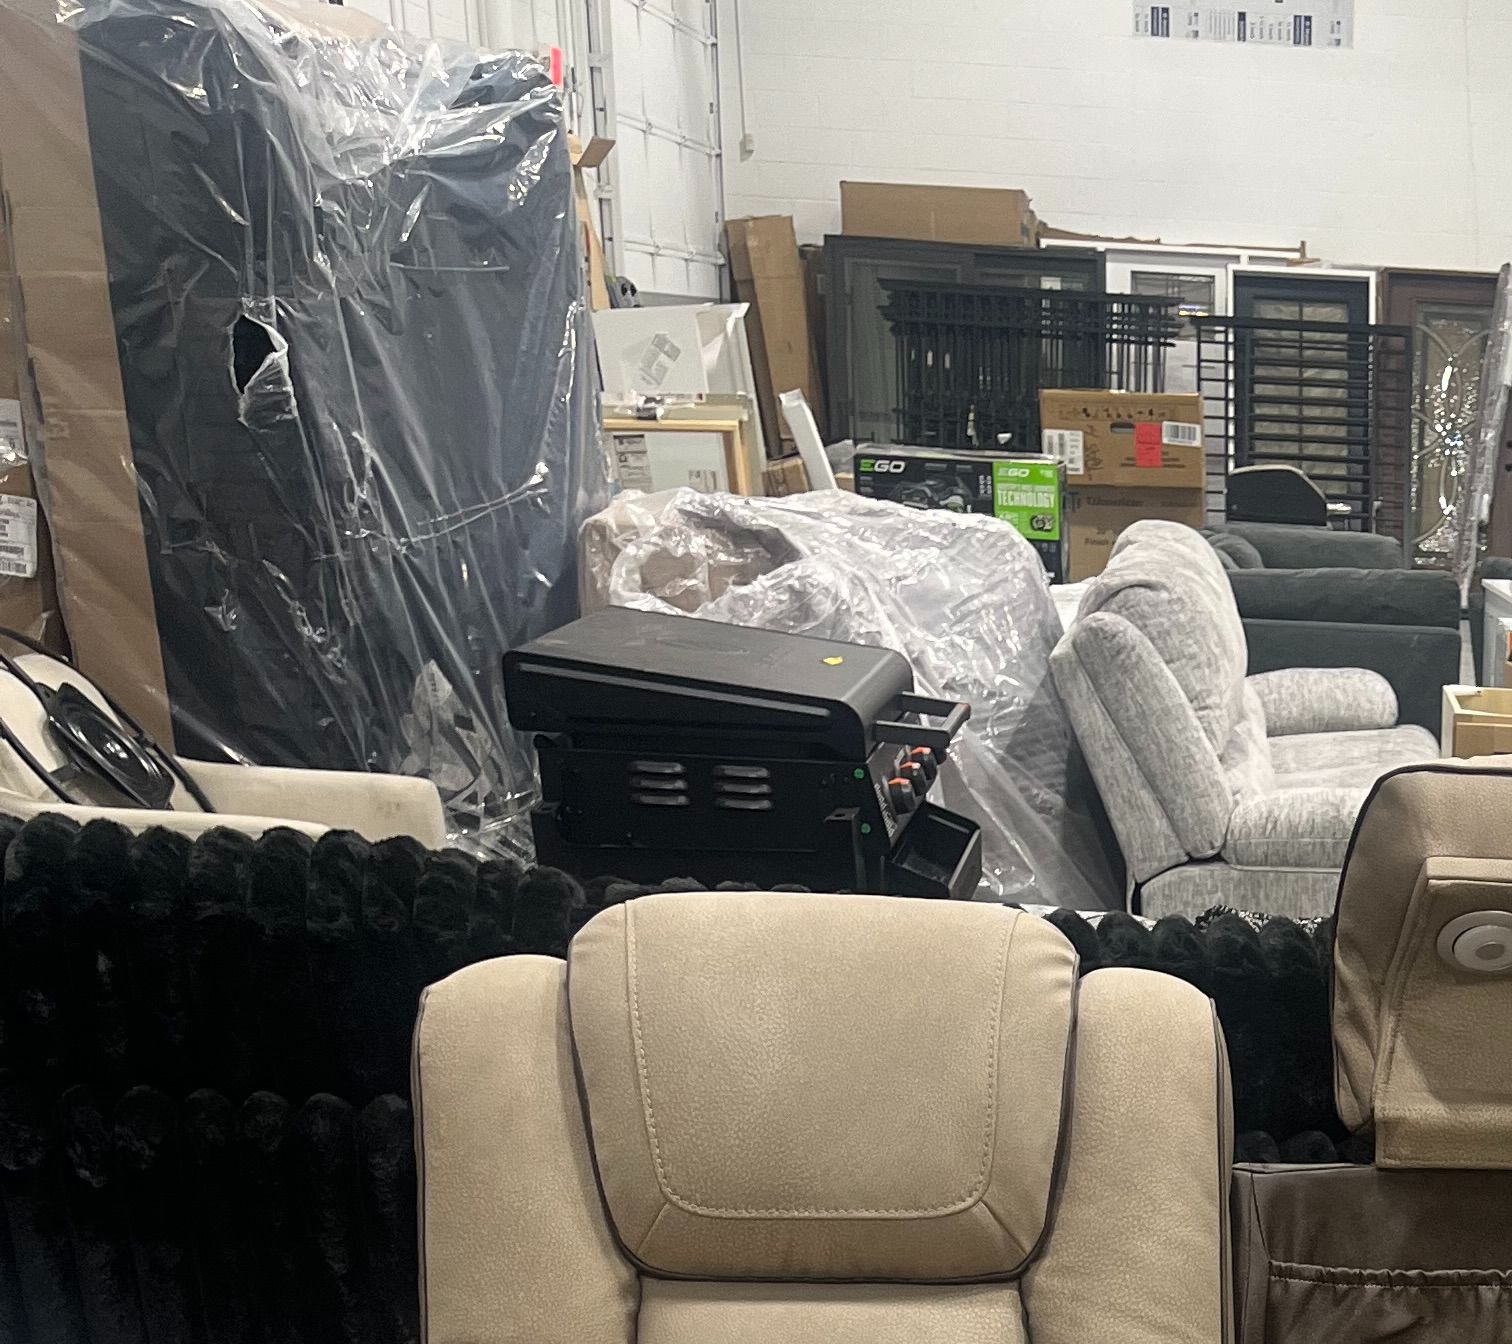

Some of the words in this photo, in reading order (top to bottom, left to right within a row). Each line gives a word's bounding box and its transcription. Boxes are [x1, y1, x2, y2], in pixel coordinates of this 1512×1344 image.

[859, 459, 907, 474] EGO
[998, 468, 1031, 478] EGO
[998, 490, 1056, 508] TECHNOLOGY
